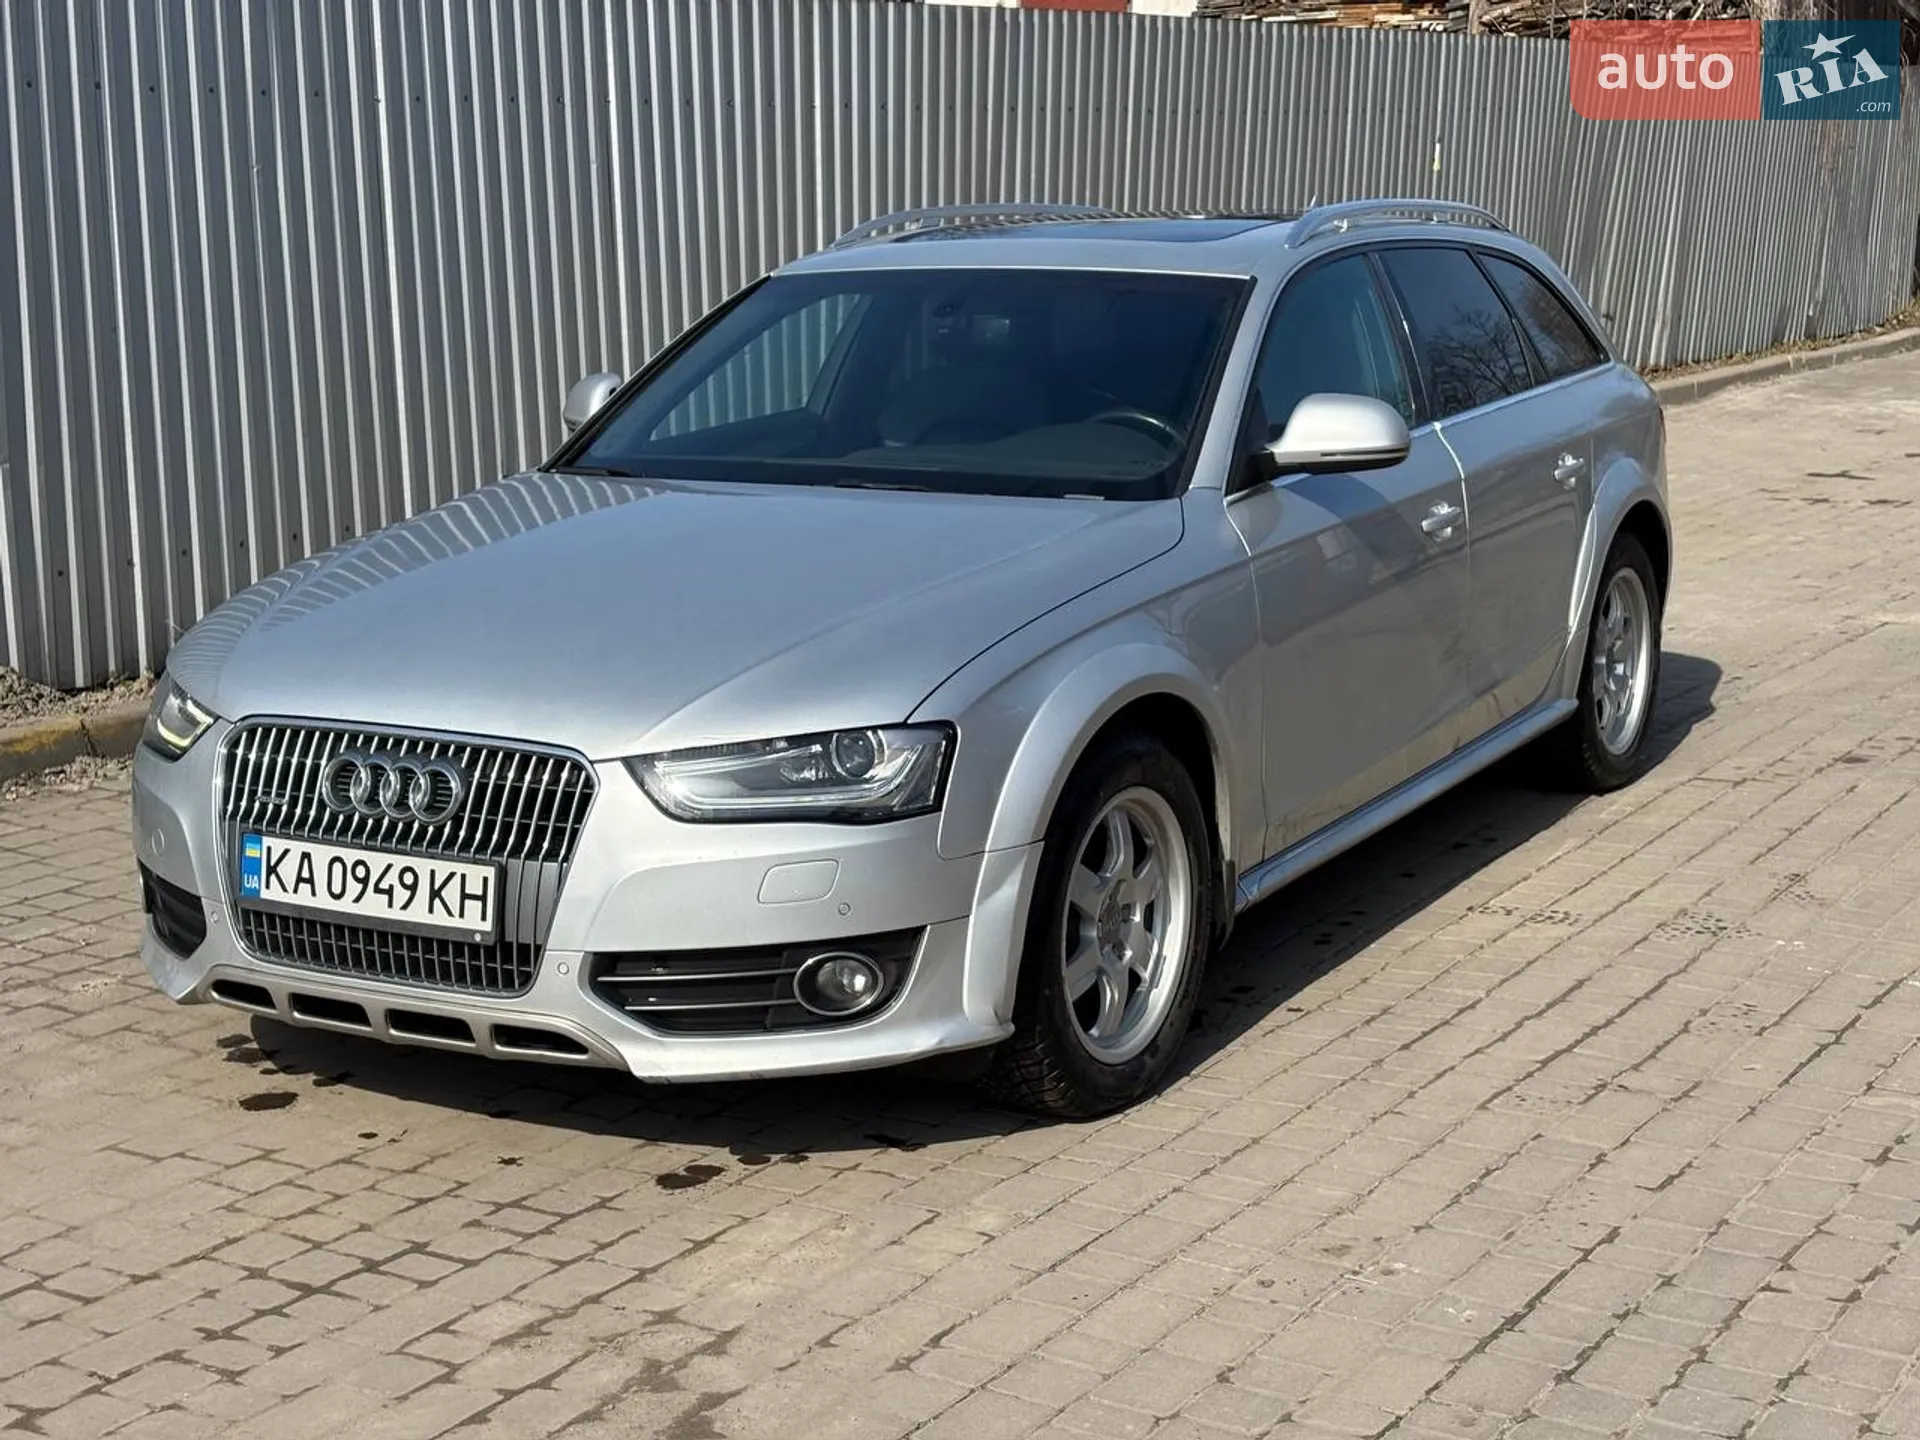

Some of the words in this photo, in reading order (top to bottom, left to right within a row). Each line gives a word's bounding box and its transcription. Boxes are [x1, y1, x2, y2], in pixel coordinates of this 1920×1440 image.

[244, 874, 260, 889] UA
[265, 846, 317, 897] KA
[327, 855, 419, 911] 0949
[428, 869, 489, 922] KH
